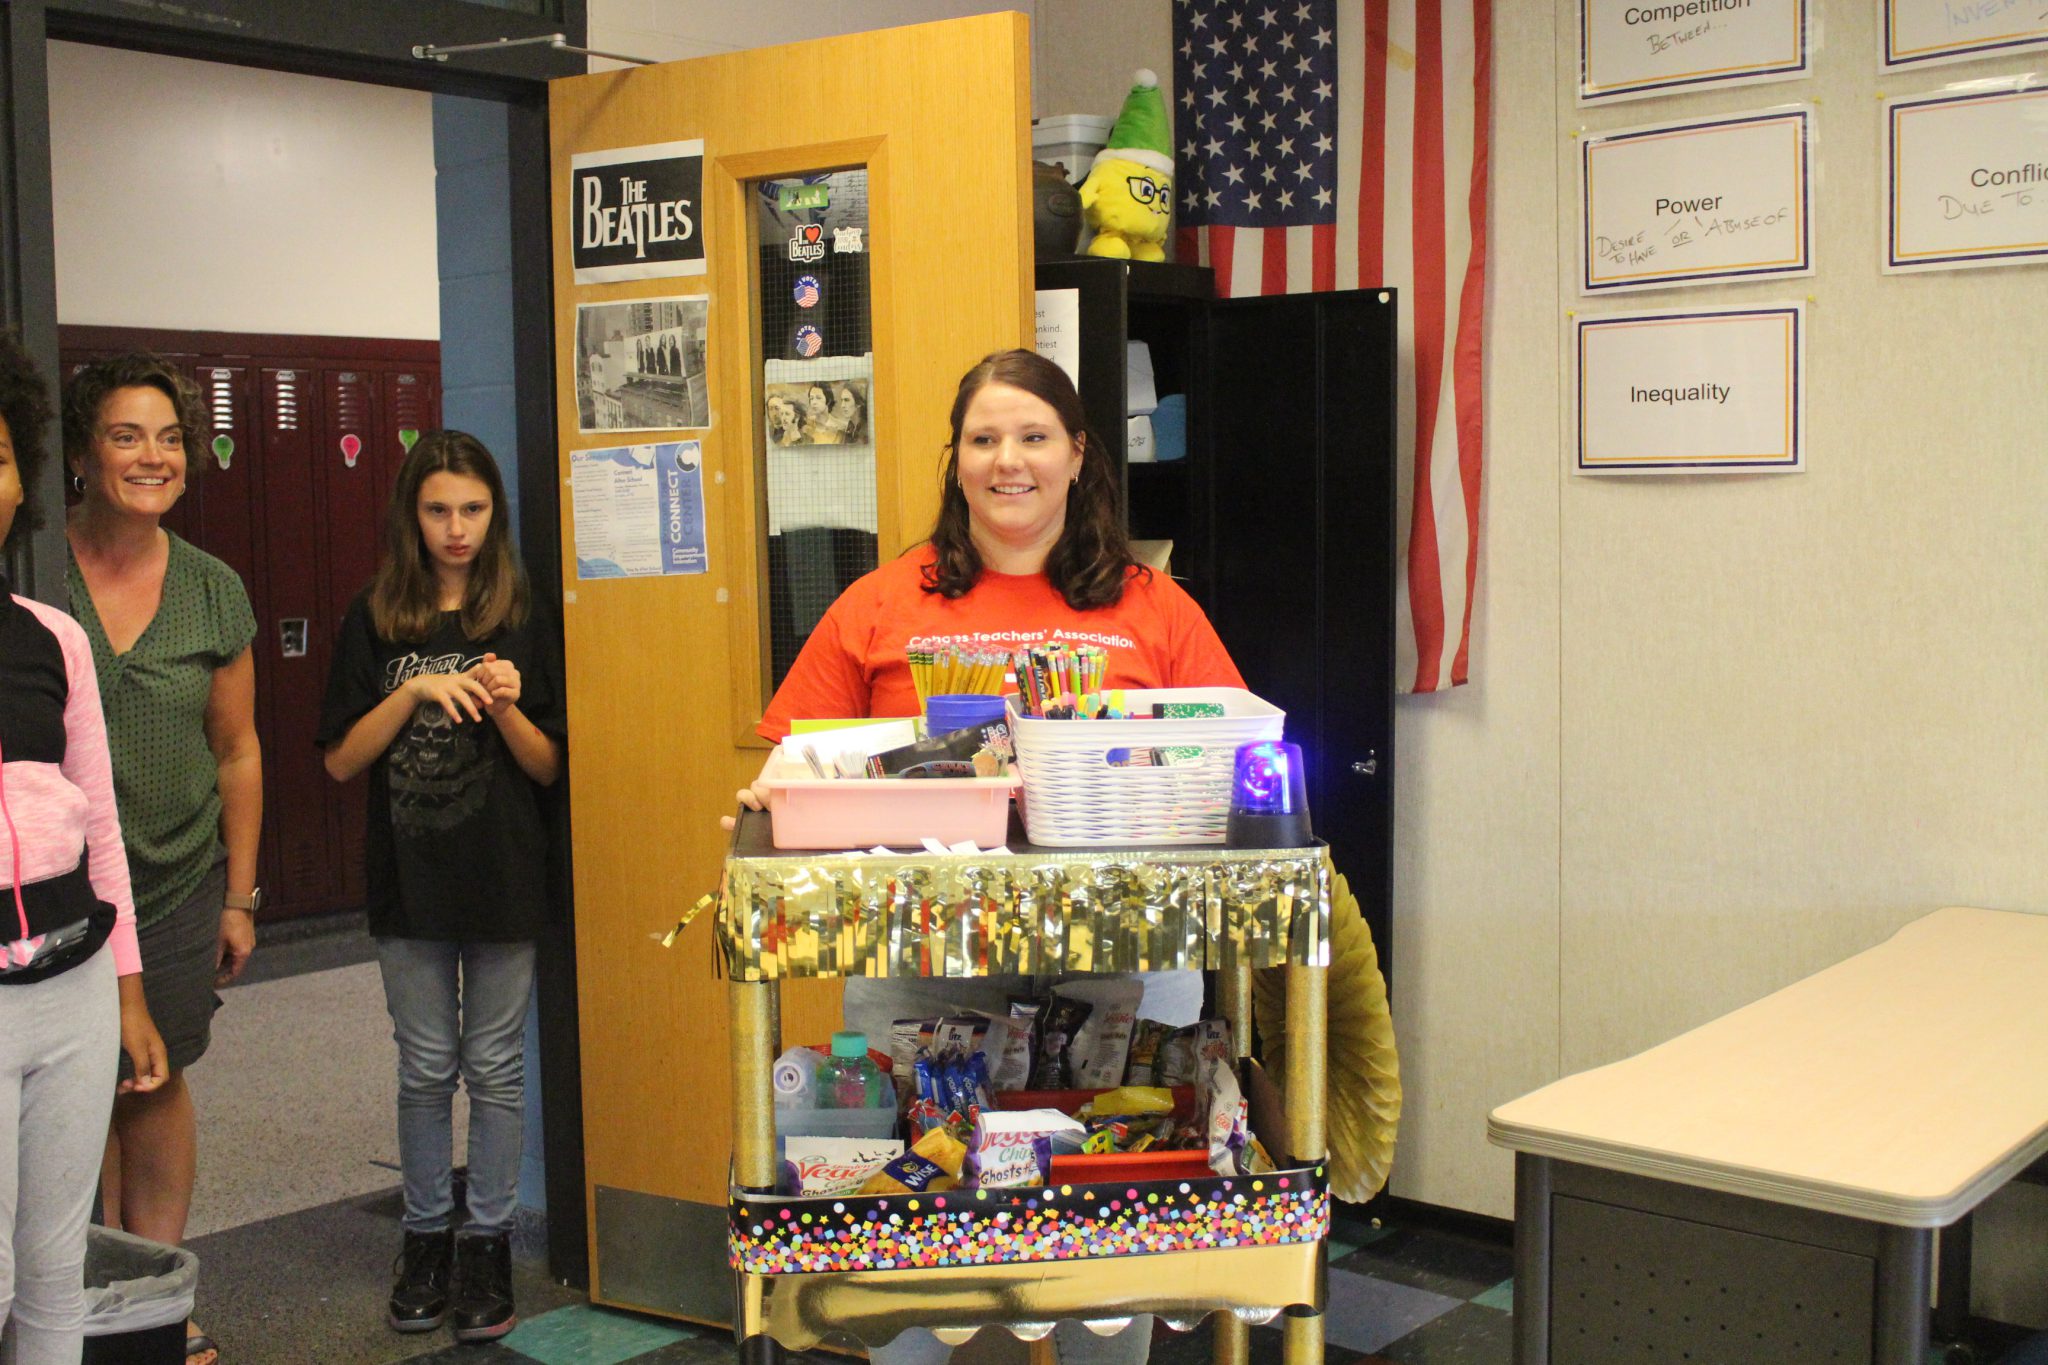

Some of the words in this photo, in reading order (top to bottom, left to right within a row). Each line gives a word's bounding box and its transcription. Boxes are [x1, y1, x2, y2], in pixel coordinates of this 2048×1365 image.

[1625, 0, 1750, 25] Competition
[582, 176, 693, 258] BEATLES
[1656, 196, 1722, 216] Power
[1035, 324, 1062, 333] nkind.
[1631, 383, 1730, 406] Inequality
[668, 471, 681, 543] CONNECT
[905, 1164, 938, 1187] WISE
[981, 1164, 1022, 1185] Ghosts
